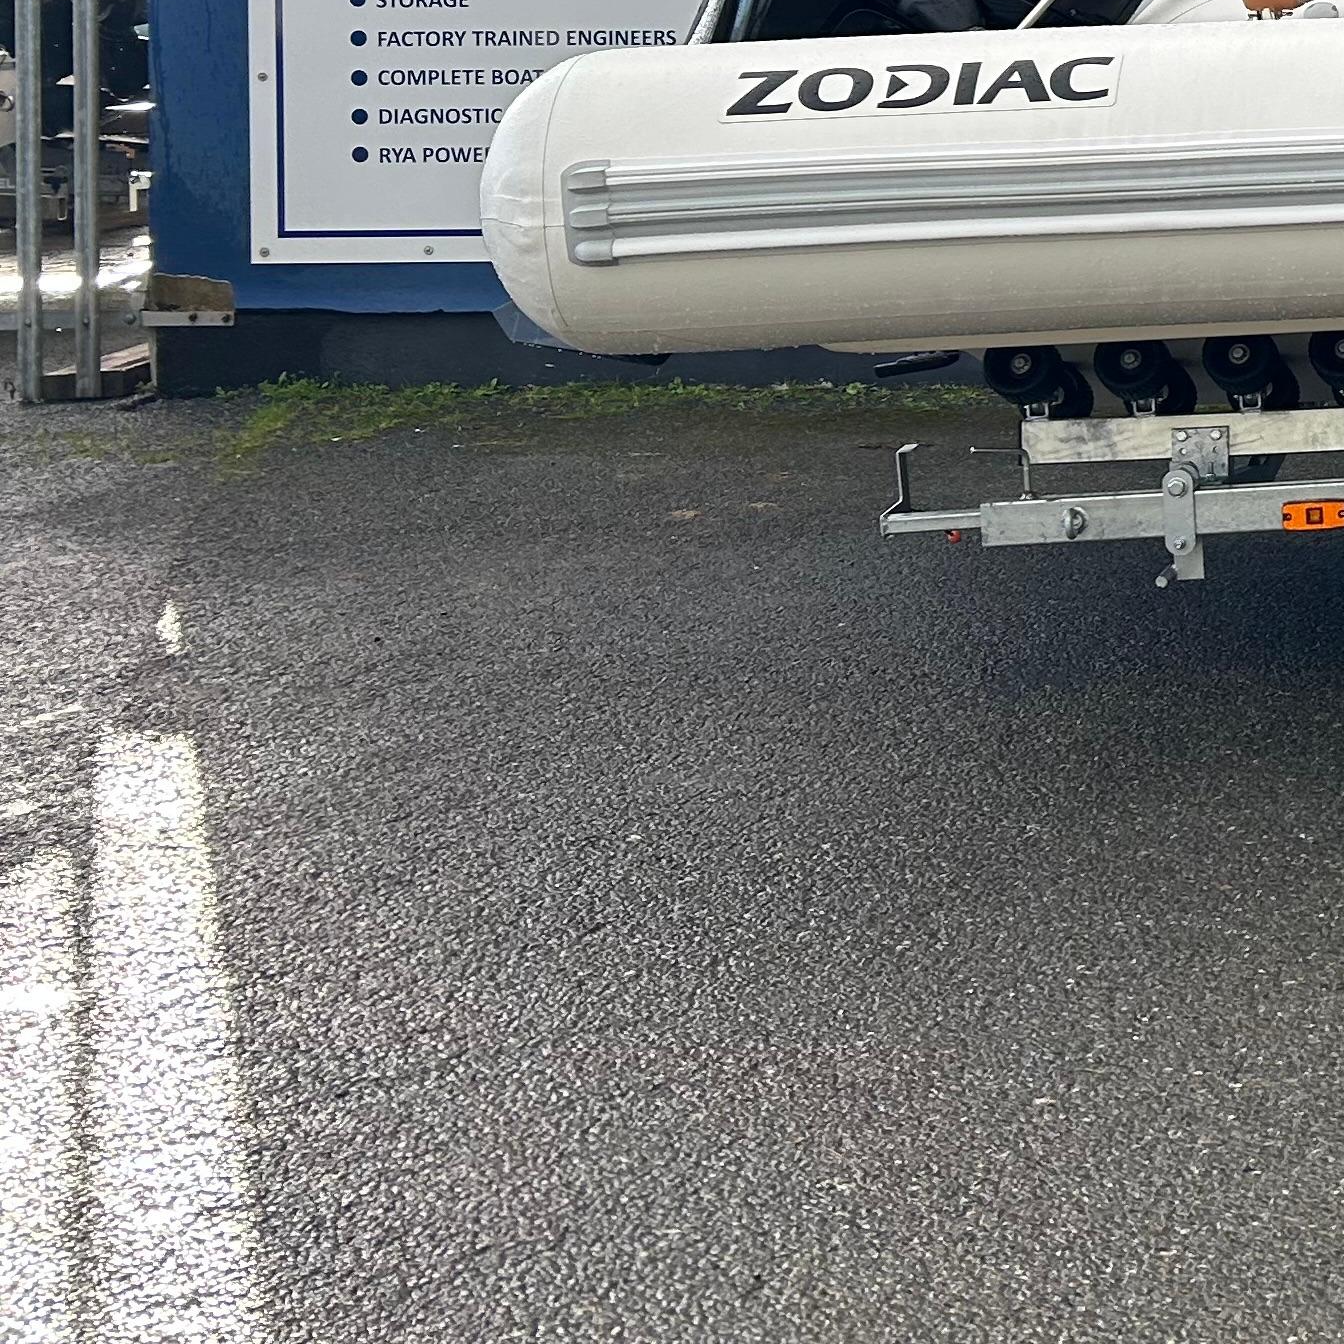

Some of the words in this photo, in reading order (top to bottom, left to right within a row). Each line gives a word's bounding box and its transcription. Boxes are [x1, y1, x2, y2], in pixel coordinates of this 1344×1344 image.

[378, 31, 467, 47] FACTORY
[472, 31, 560, 47] TRAINED
[567, 30, 677, 46] ENGINEERS
[378, 69, 486, 86] COMPLETE
[726, 57, 1115, 116] ZODIAC
[380, 147, 417, 163] RYA
